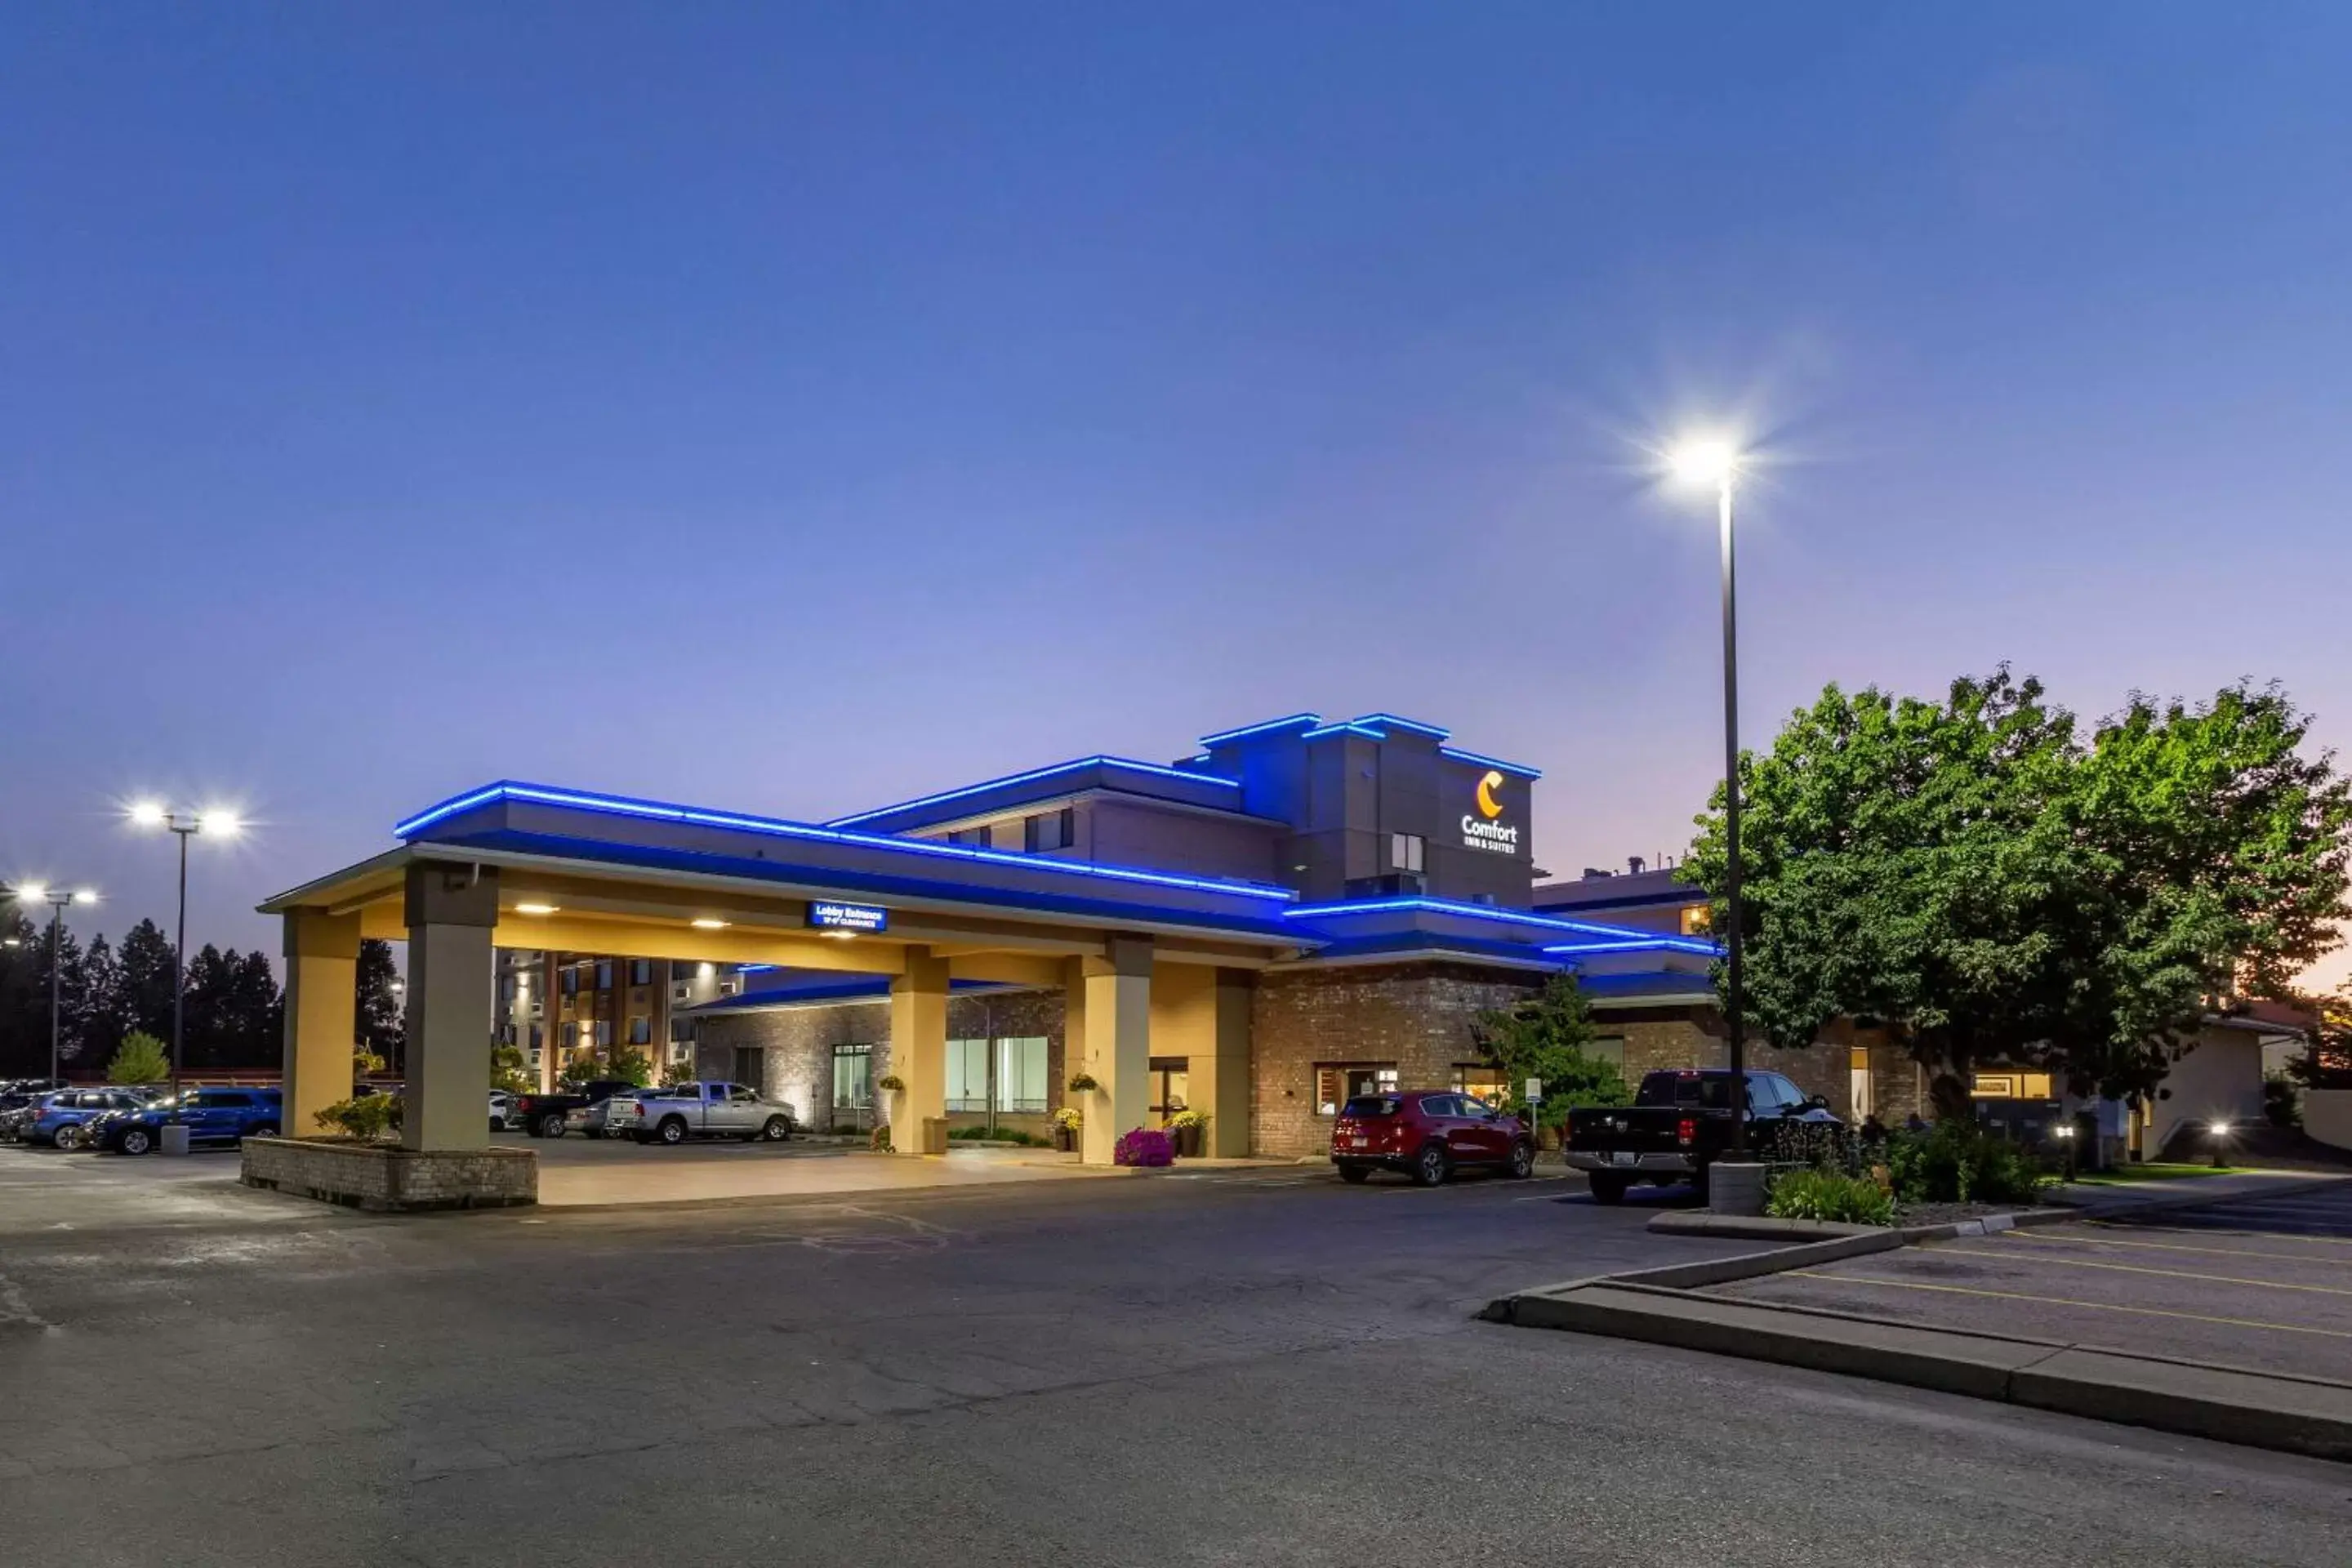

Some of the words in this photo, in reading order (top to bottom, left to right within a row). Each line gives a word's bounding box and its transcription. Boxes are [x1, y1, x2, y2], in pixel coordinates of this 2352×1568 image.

[1462, 815, 1517, 843] Comfort
[1464, 835, 1480, 847] INN
[1481, 839, 1487, 849] &
[1488, 841, 1515, 853] SUITES
[817, 905, 844, 917] Lobby
[845, 908, 882, 920] Entrance
